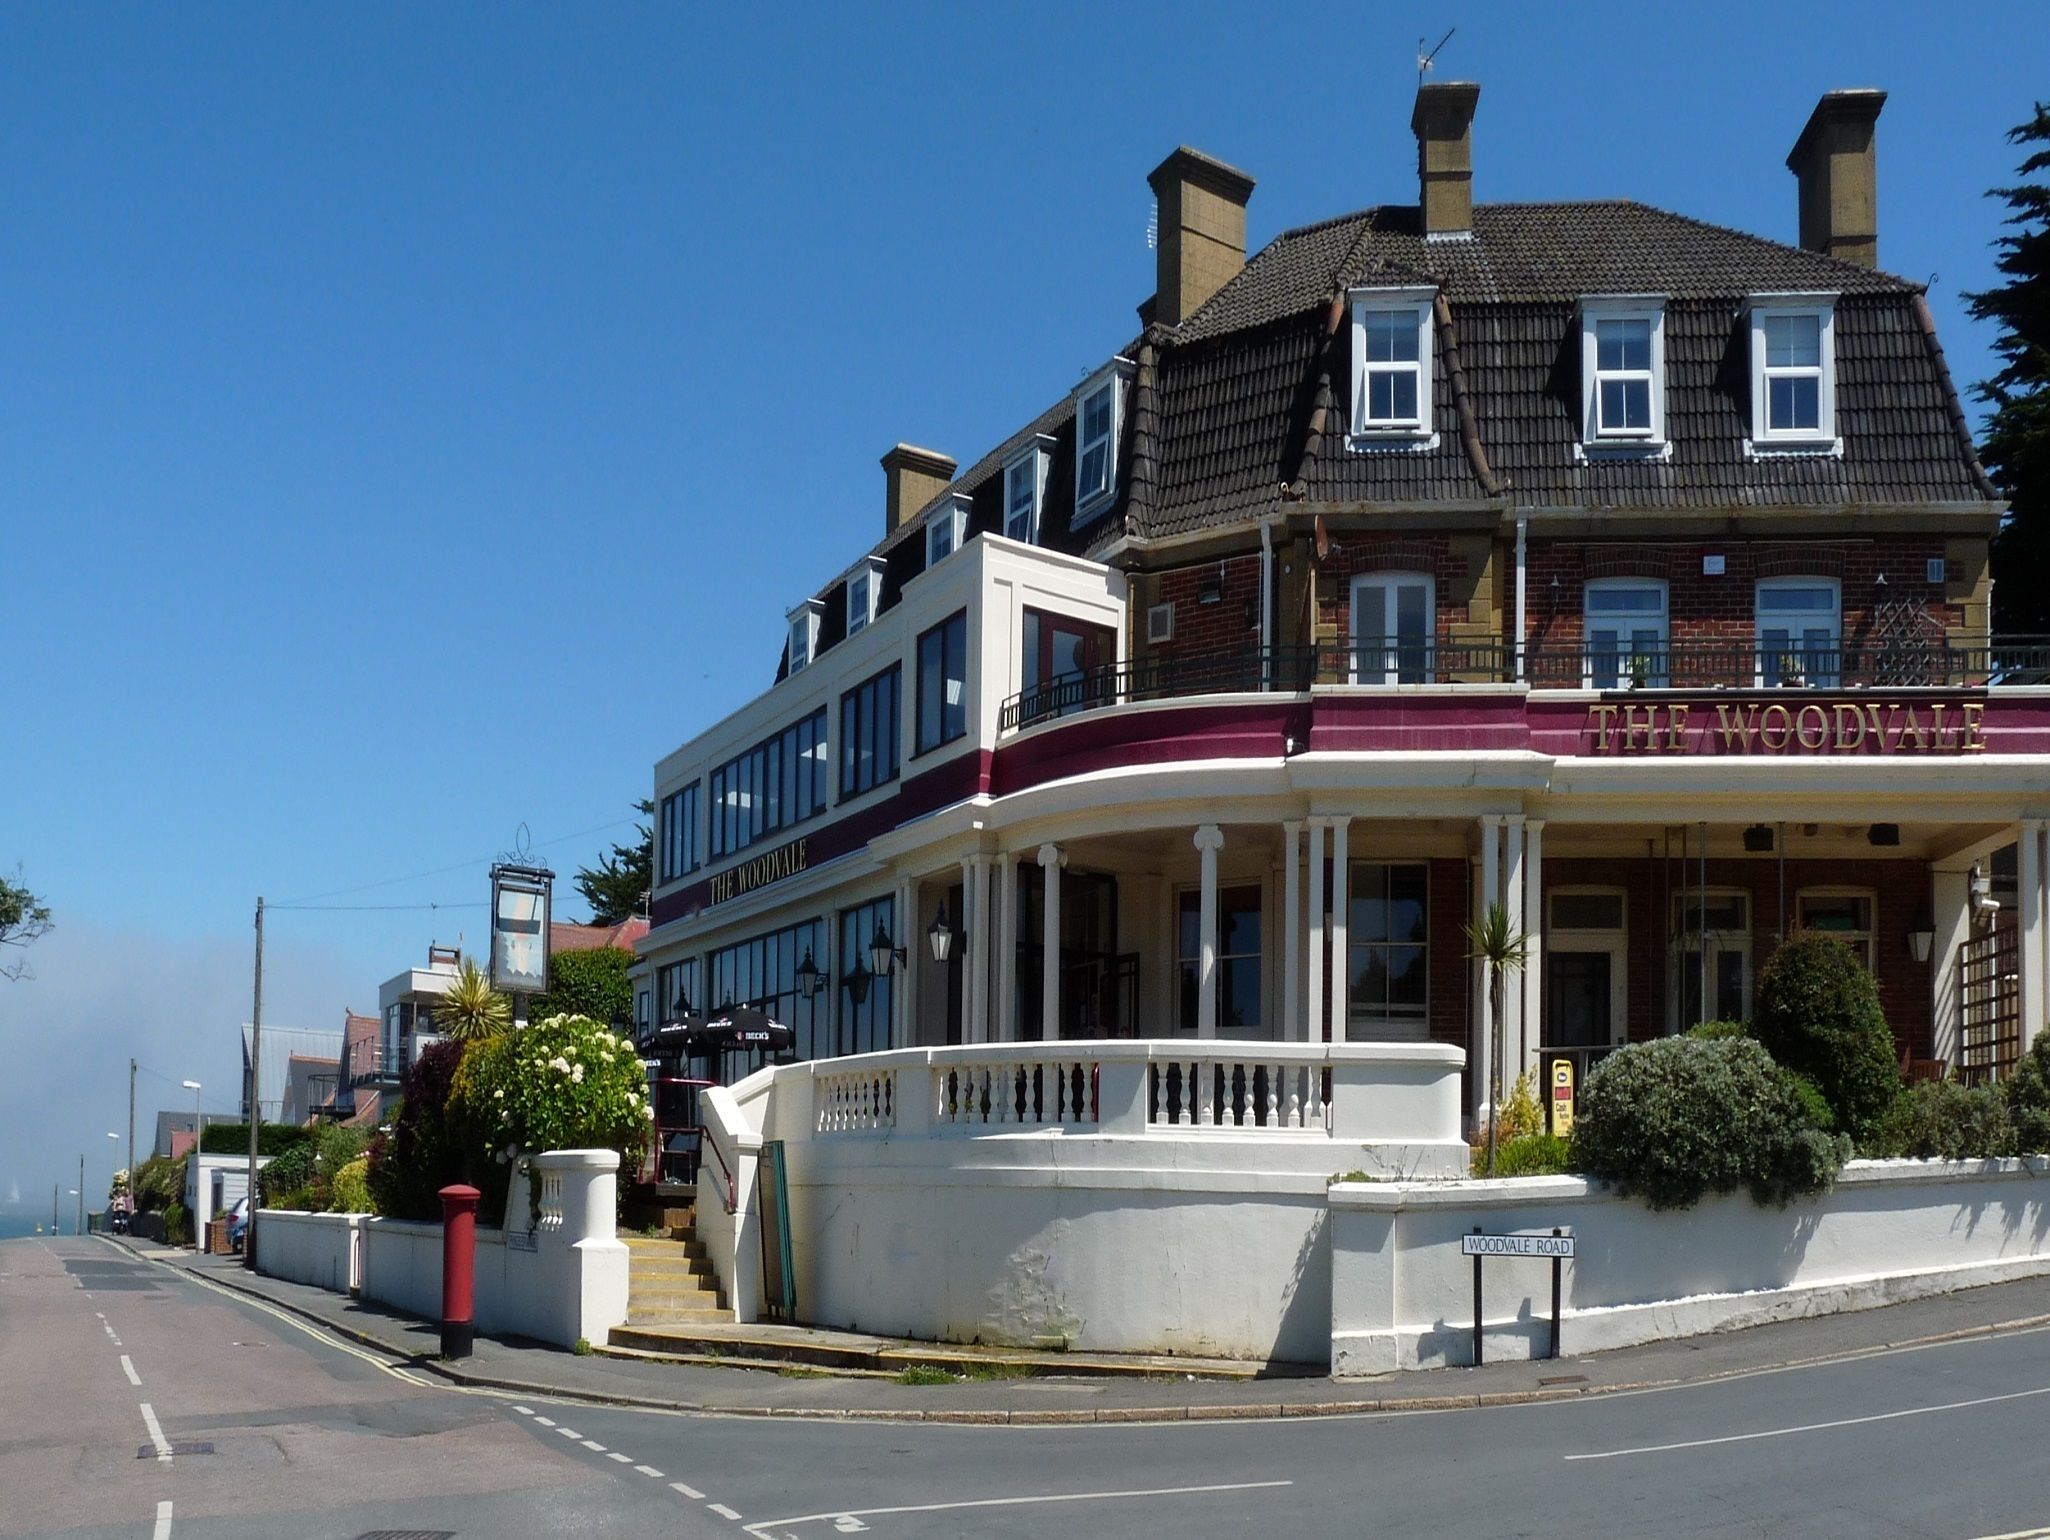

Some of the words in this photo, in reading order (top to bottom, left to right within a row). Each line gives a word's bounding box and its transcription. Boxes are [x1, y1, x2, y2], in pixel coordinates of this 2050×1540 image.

[1589, 704, 1690, 751] THE
[1715, 703, 1988, 751] WOODVALE
[710, 869, 734, 906] THE
[738, 839, 807, 893] WOODVALE
[1468, 1237, 1530, 1253] WOODVALE
[1536, 1239, 1570, 1254] ROAD
